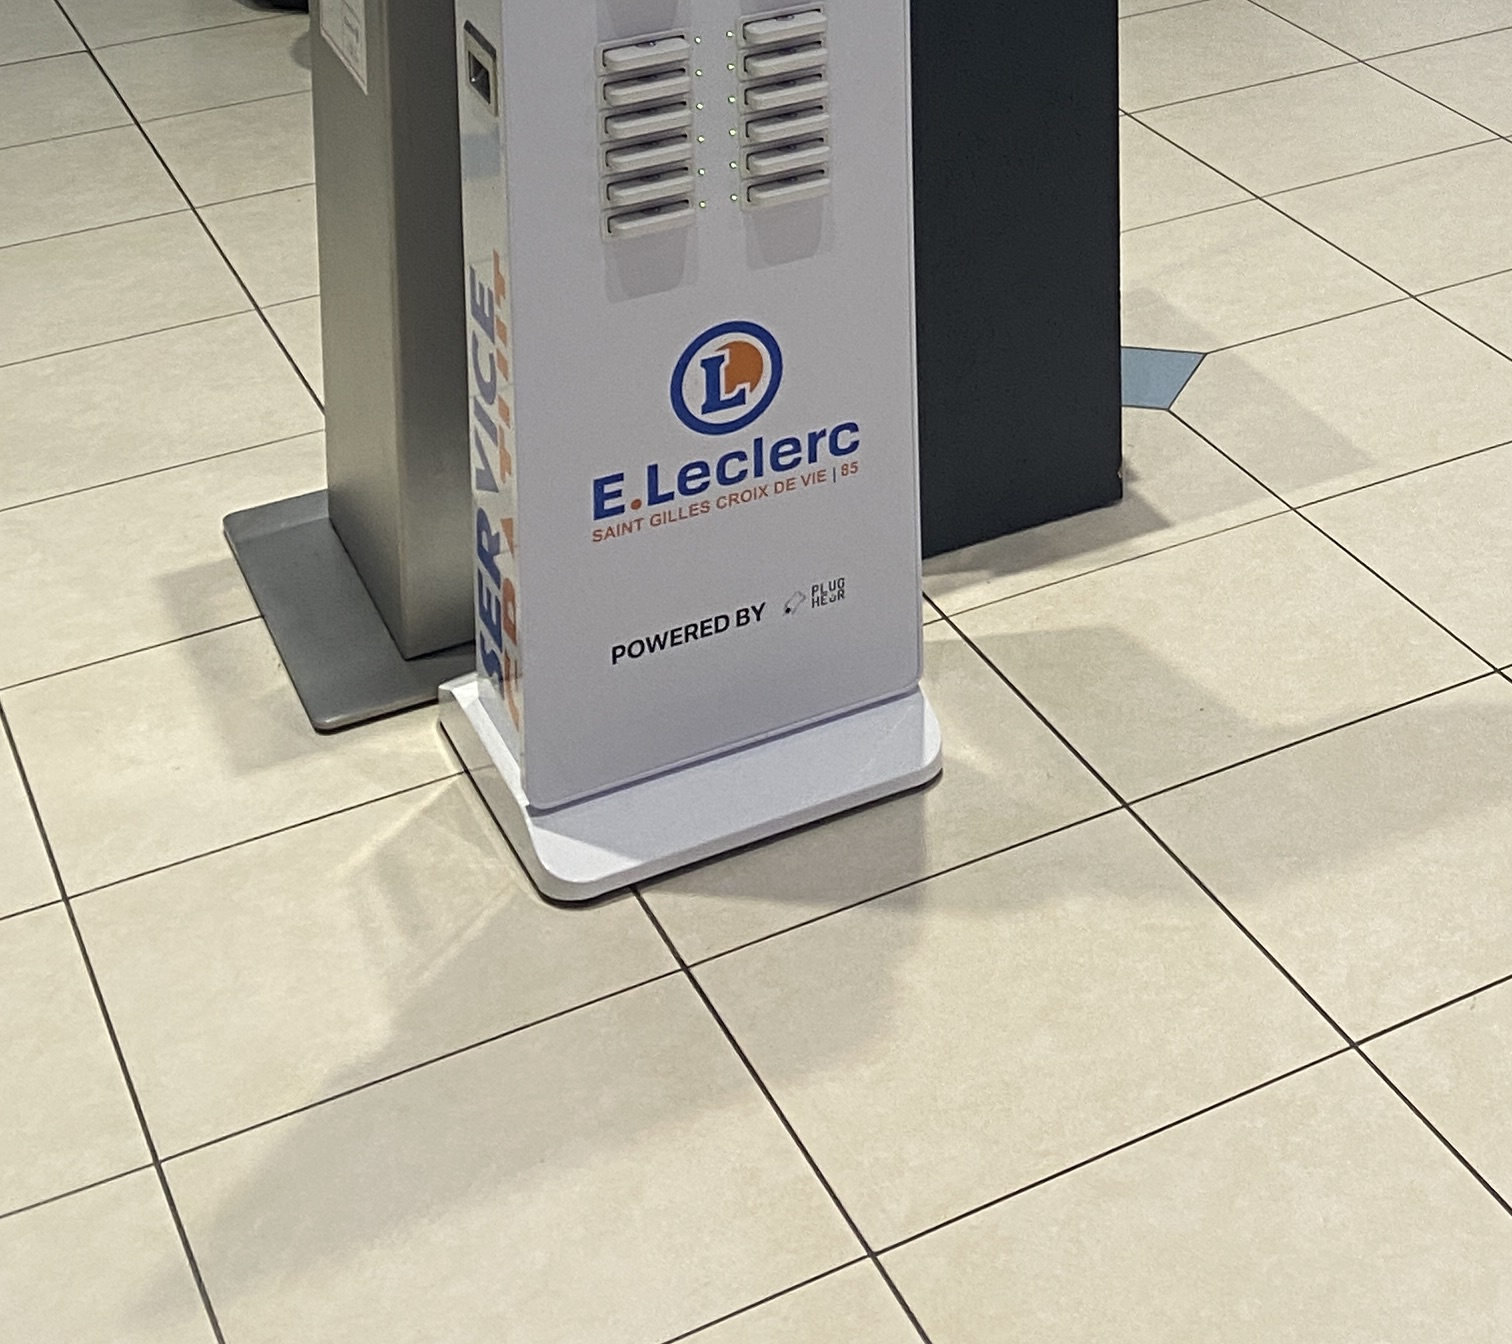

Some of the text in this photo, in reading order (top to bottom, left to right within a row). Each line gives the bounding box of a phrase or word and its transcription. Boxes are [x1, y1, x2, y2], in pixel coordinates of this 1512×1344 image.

[591, 517, 645, 543] SAINT
[649, 500, 711, 528] GILLES
[715, 484, 769, 510] CROIX
[773, 477, 797, 495] DE
[800, 469, 827, 488] VIE
[840, 461, 859, 477] 85
[592, 421, 861, 521] E.Leclerc
[810, 577, 845, 597] PLUG
[611, 601, 767, 665] POWERED BY
